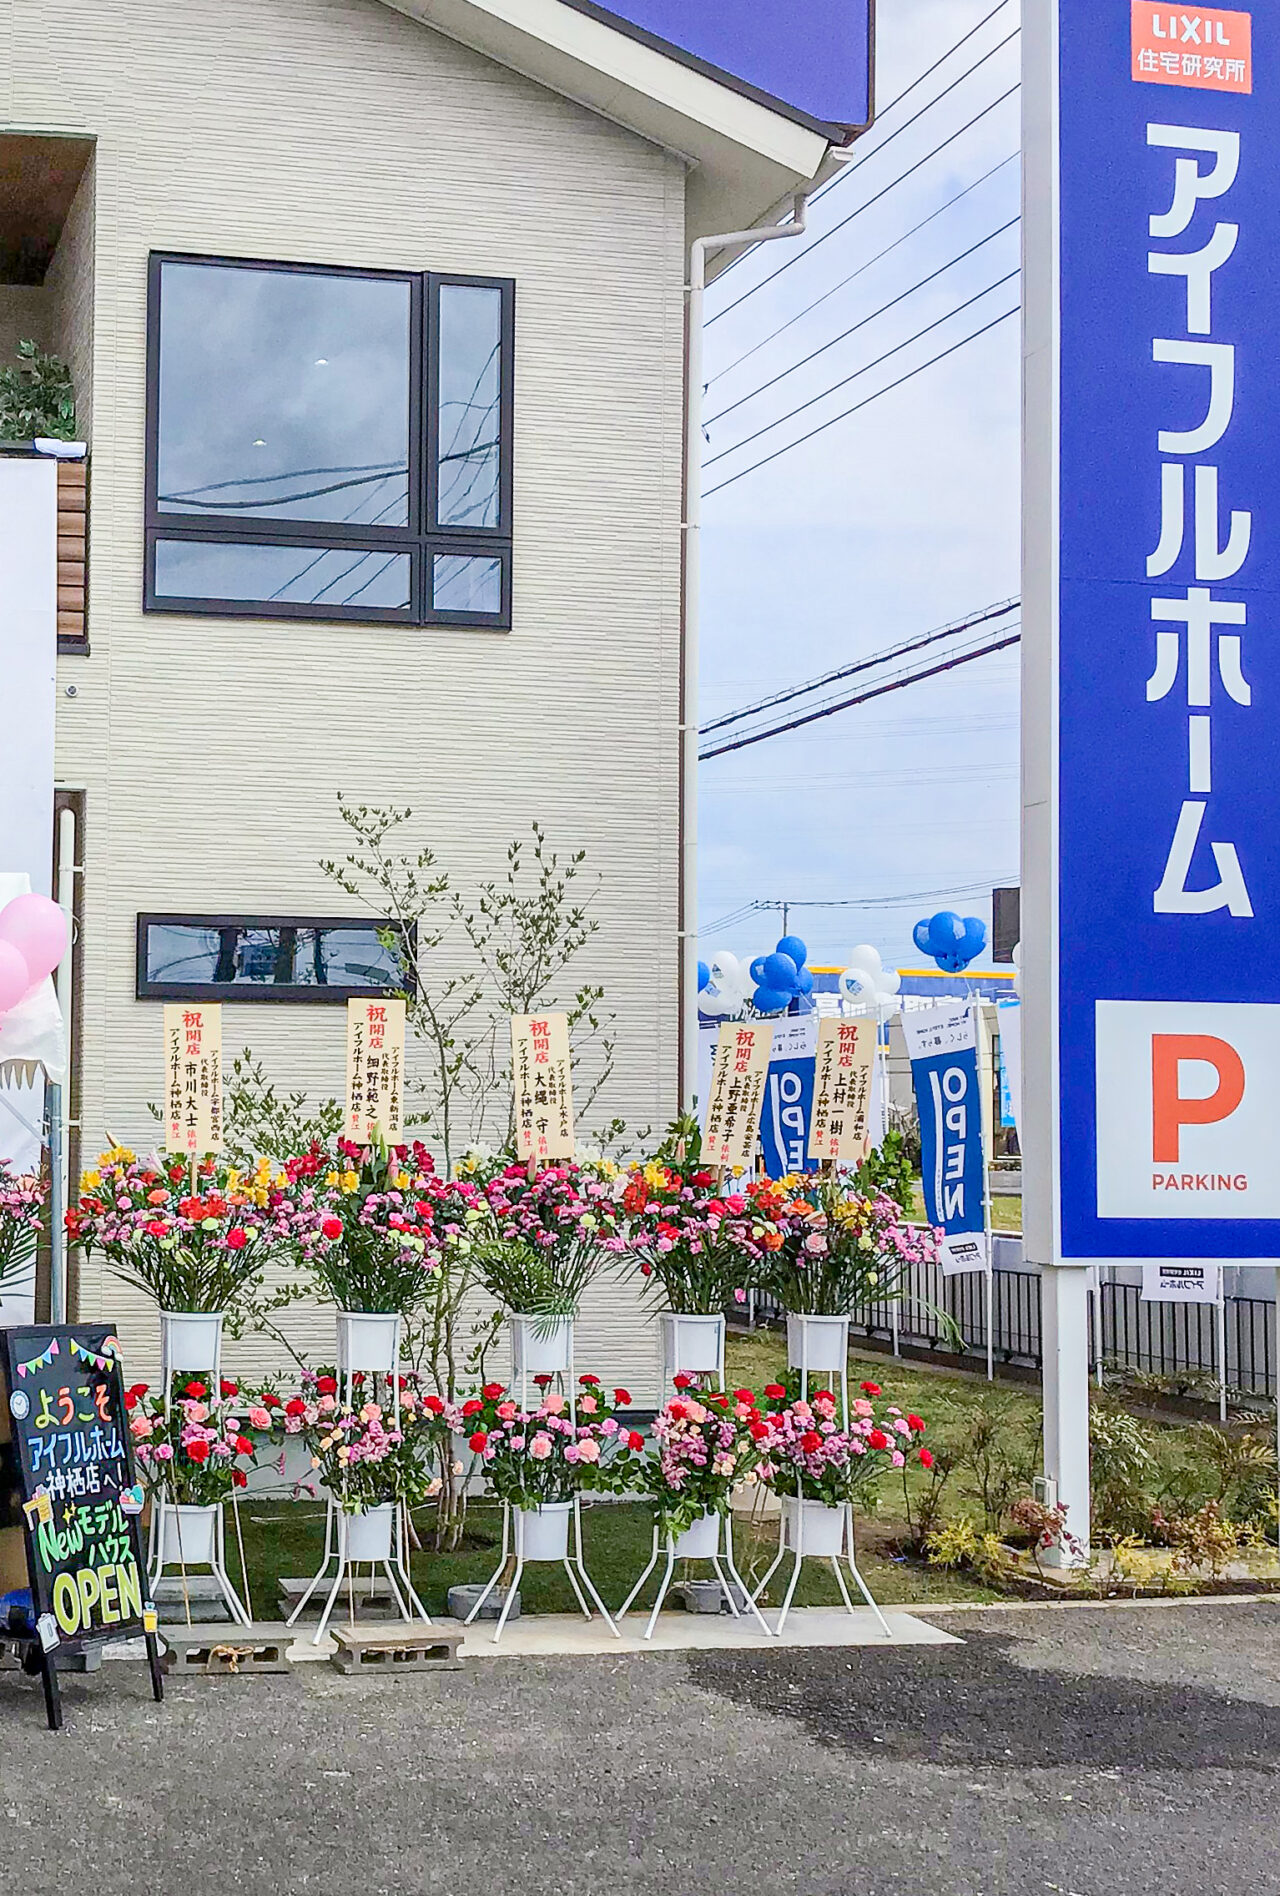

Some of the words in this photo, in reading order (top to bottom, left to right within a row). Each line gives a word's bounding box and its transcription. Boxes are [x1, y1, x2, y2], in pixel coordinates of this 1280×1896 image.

[1152, 14, 1231, 46] LIXIL
[1137, 48, 1246, 83] 住宅研究所
[1146, 122, 1255, 918] アイフルホーム
[182, 1009, 204, 1056] 祝開店
[366, 1004, 388, 1049] 祝開店
[529, 1019, 551, 1064] 祝開店
[836, 1023, 859, 1067] 祝開店
[733, 1028, 755, 1073] 祝開店
[1151, 1033, 1246, 1163] P
[1152, 1173, 1248, 1191] PARKING
[34, 1383, 113, 1429] ようこそ
[28, 1429, 126, 1473] アイフルホーム
[77, 1499, 130, 1537] モデル
[37, 1520, 83, 1574] New
[88, 1534, 135, 1567] ハウス
[53, 1561, 143, 1636] OPEN
